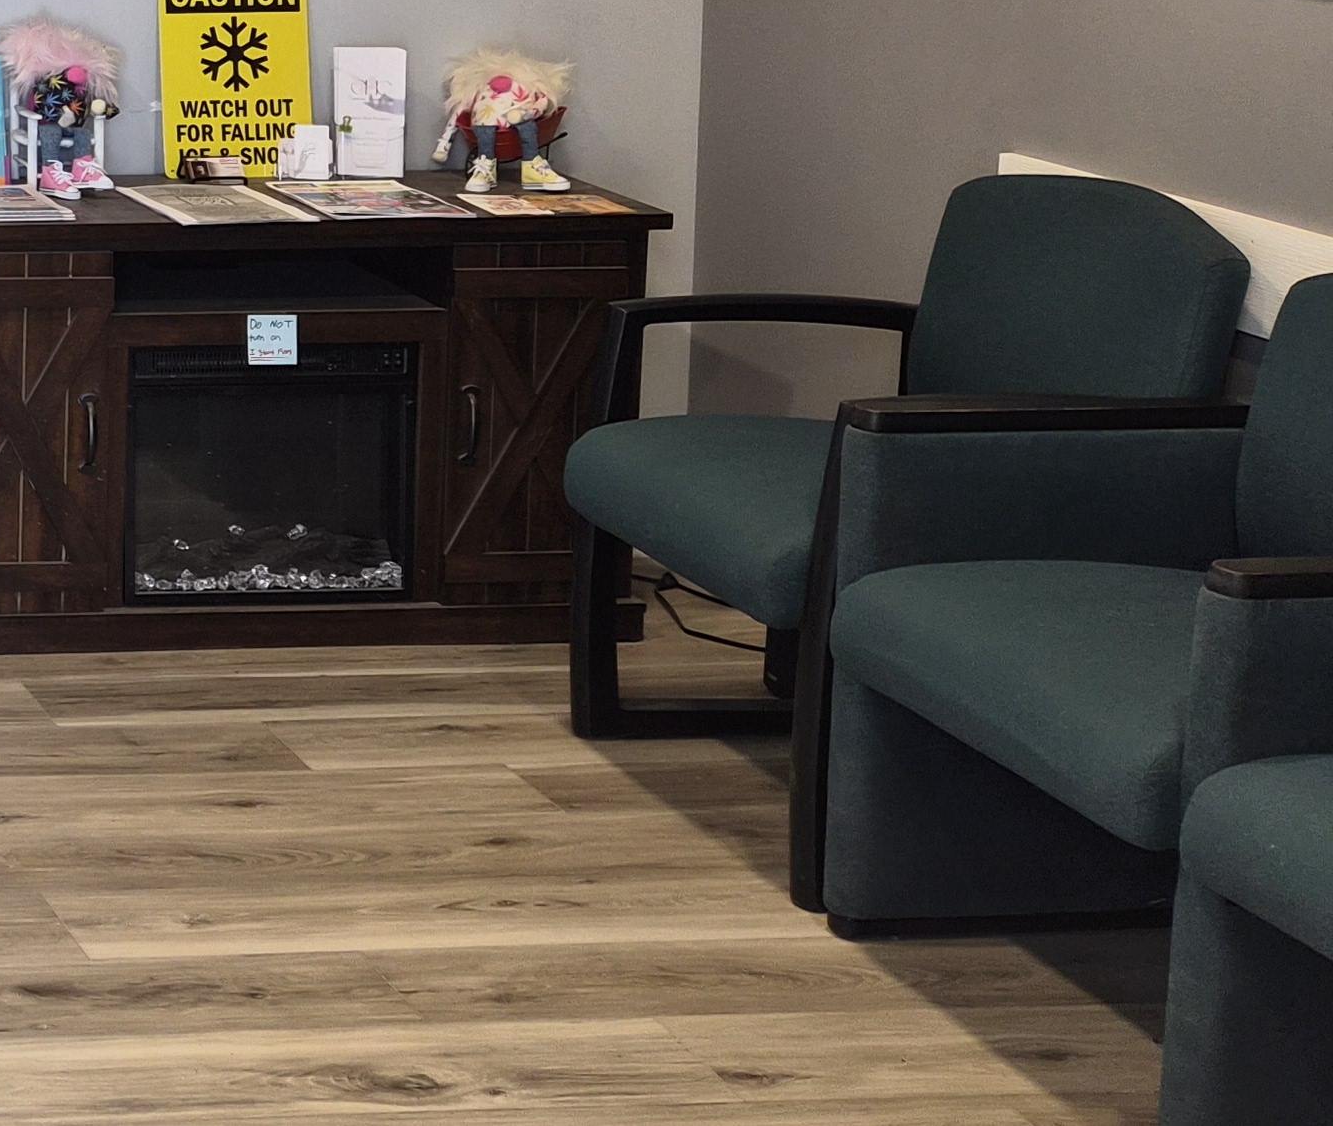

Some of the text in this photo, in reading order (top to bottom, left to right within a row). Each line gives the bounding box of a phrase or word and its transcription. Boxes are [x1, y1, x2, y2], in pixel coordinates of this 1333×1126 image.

[180, 99, 294, 118] WATCH OUT
[176, 124, 214, 142] FOR
[240, 146, 279, 165] SNO
[249, 318, 294, 330] Do NOT
